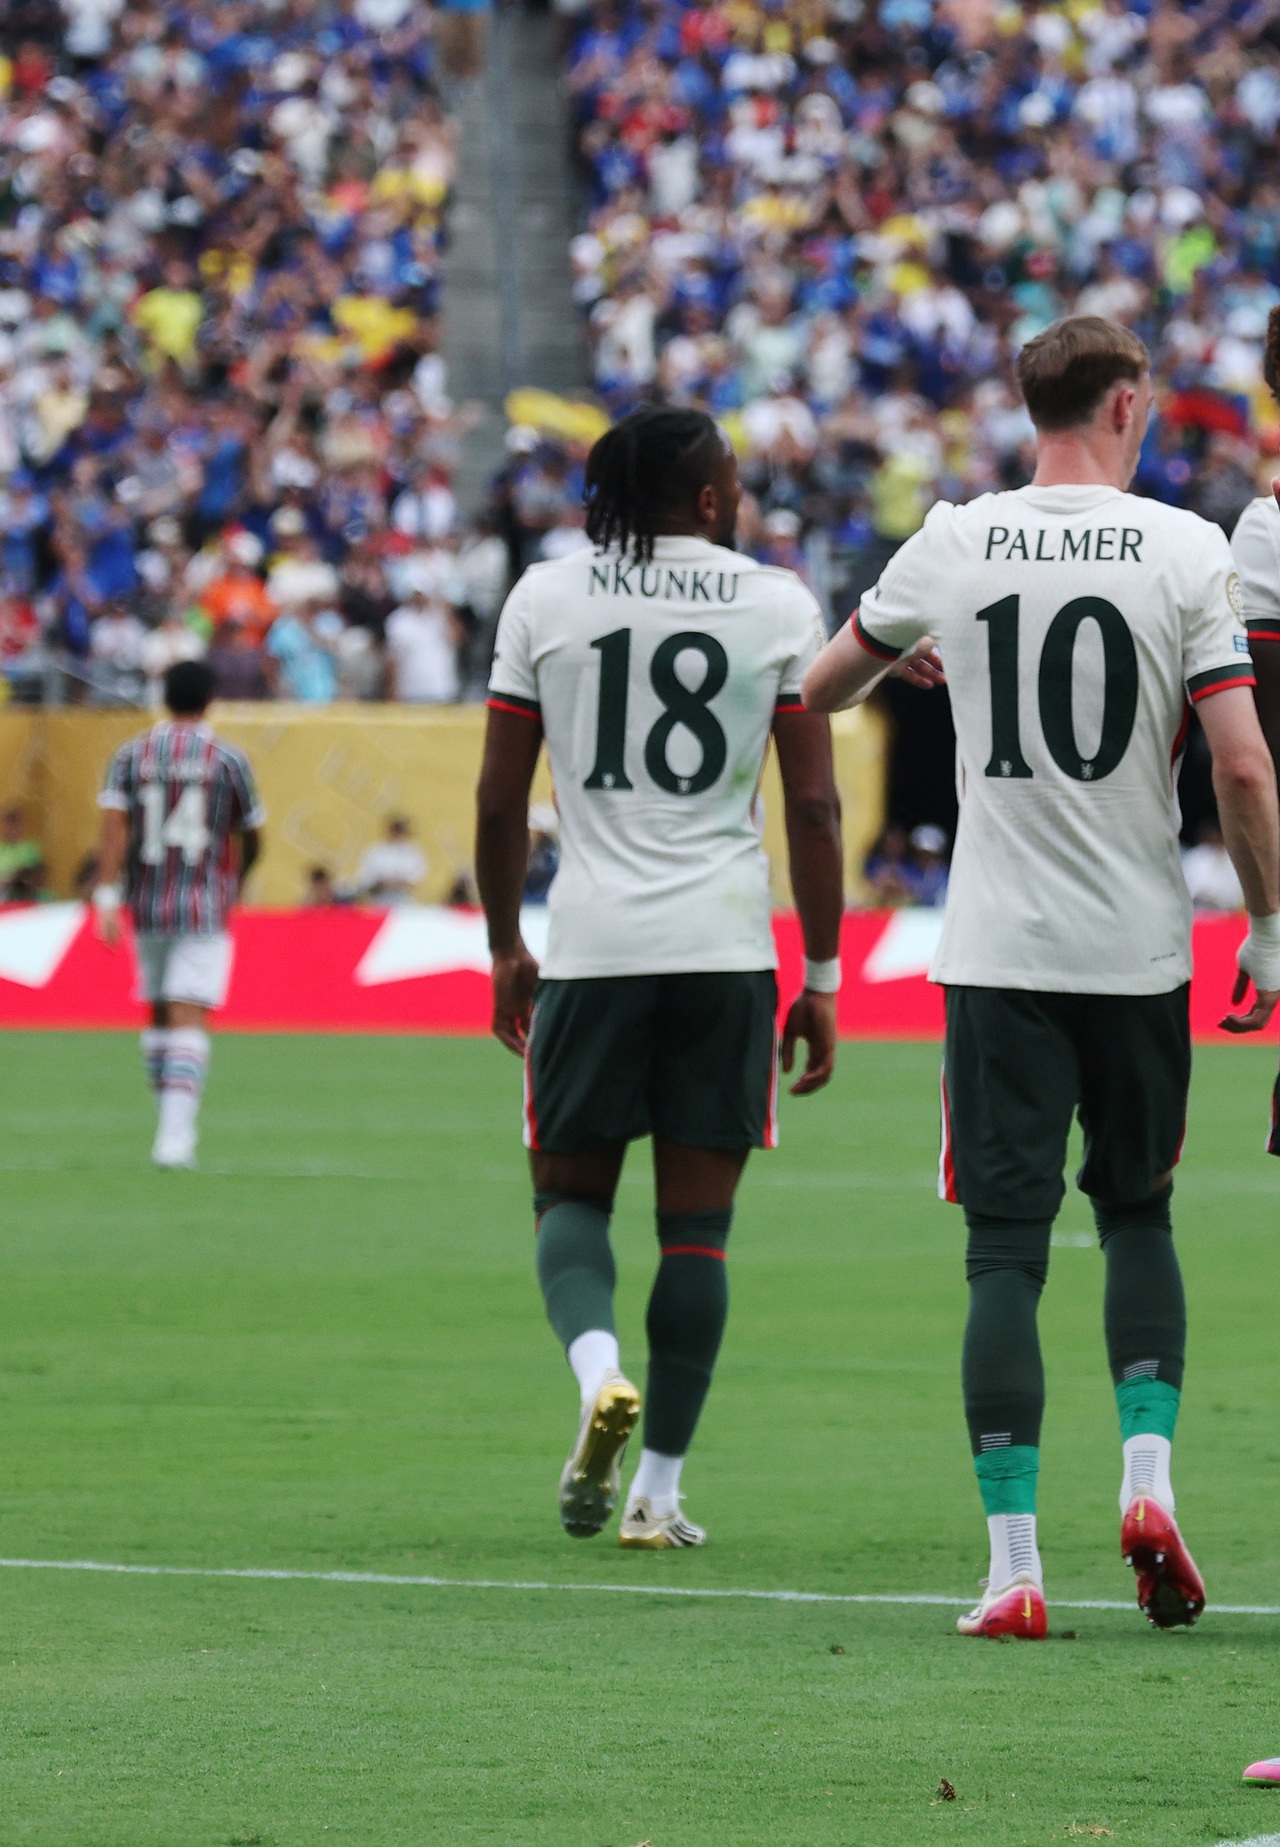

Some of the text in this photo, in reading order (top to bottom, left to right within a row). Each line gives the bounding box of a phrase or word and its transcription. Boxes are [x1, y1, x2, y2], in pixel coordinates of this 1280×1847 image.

[588, 565, 739, 603] NKUNKU
[985, 527, 1143, 562] PALMER
[583, 628, 728, 795] 18
[976, 594, 1139, 781] 10
[138, 785, 210, 866] 14
